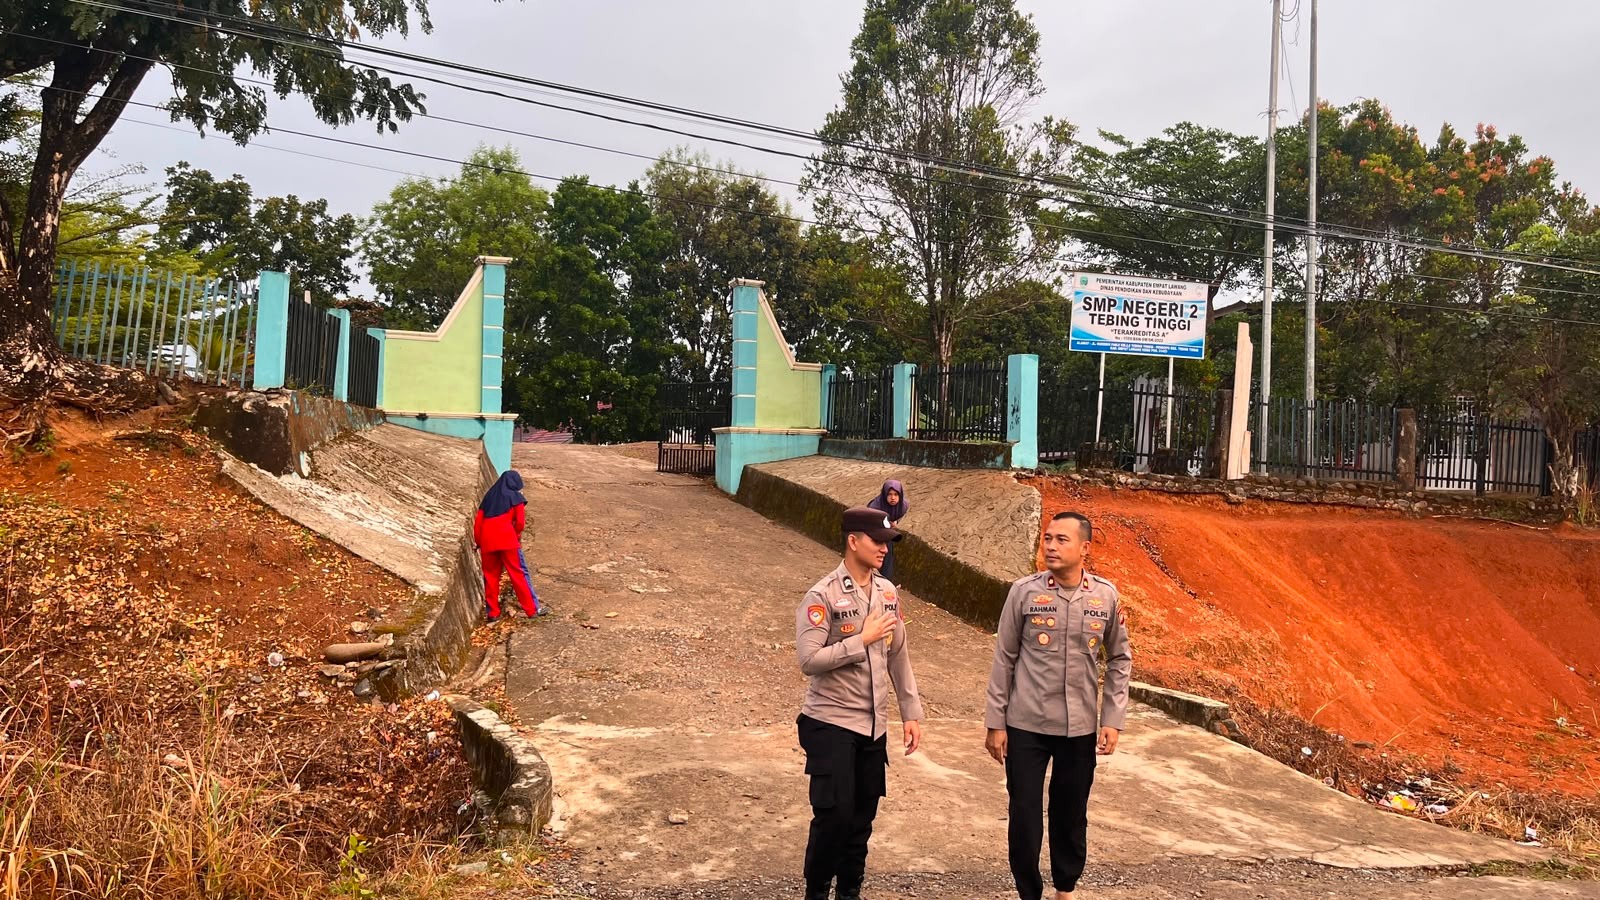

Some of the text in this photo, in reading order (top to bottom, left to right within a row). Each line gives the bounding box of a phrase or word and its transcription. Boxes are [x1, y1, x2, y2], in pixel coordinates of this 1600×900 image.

[1096, 277, 1125, 286] PEMERINTAH
[1125, 280, 1152, 288] KABUPATEN
[1082, 296, 1198, 318] SMP NEGERI 2
[1088, 313, 1191, 331] TEBING TINGGI
[833, 608, 860, 620] ERIK
[1083, 609, 1108, 618] POLRI
